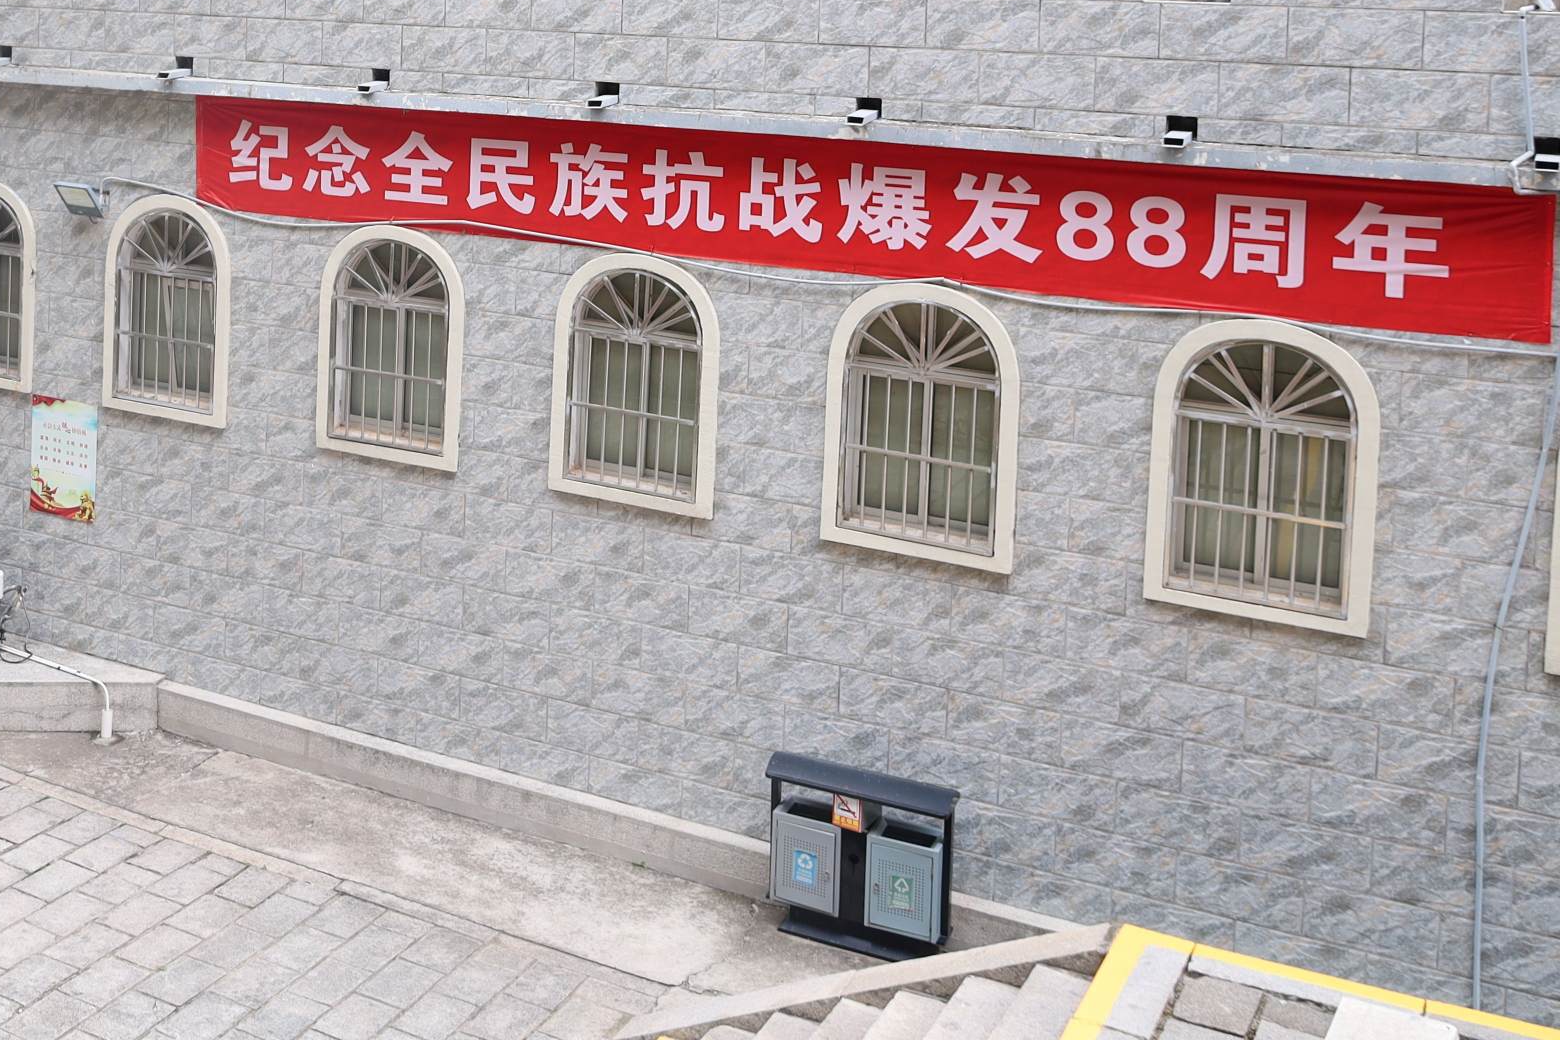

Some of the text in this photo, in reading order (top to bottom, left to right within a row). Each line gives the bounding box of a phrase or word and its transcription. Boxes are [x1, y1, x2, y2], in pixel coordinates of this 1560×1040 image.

[227, 118, 1451, 301] 纪念全民族抗战爆发88周年
